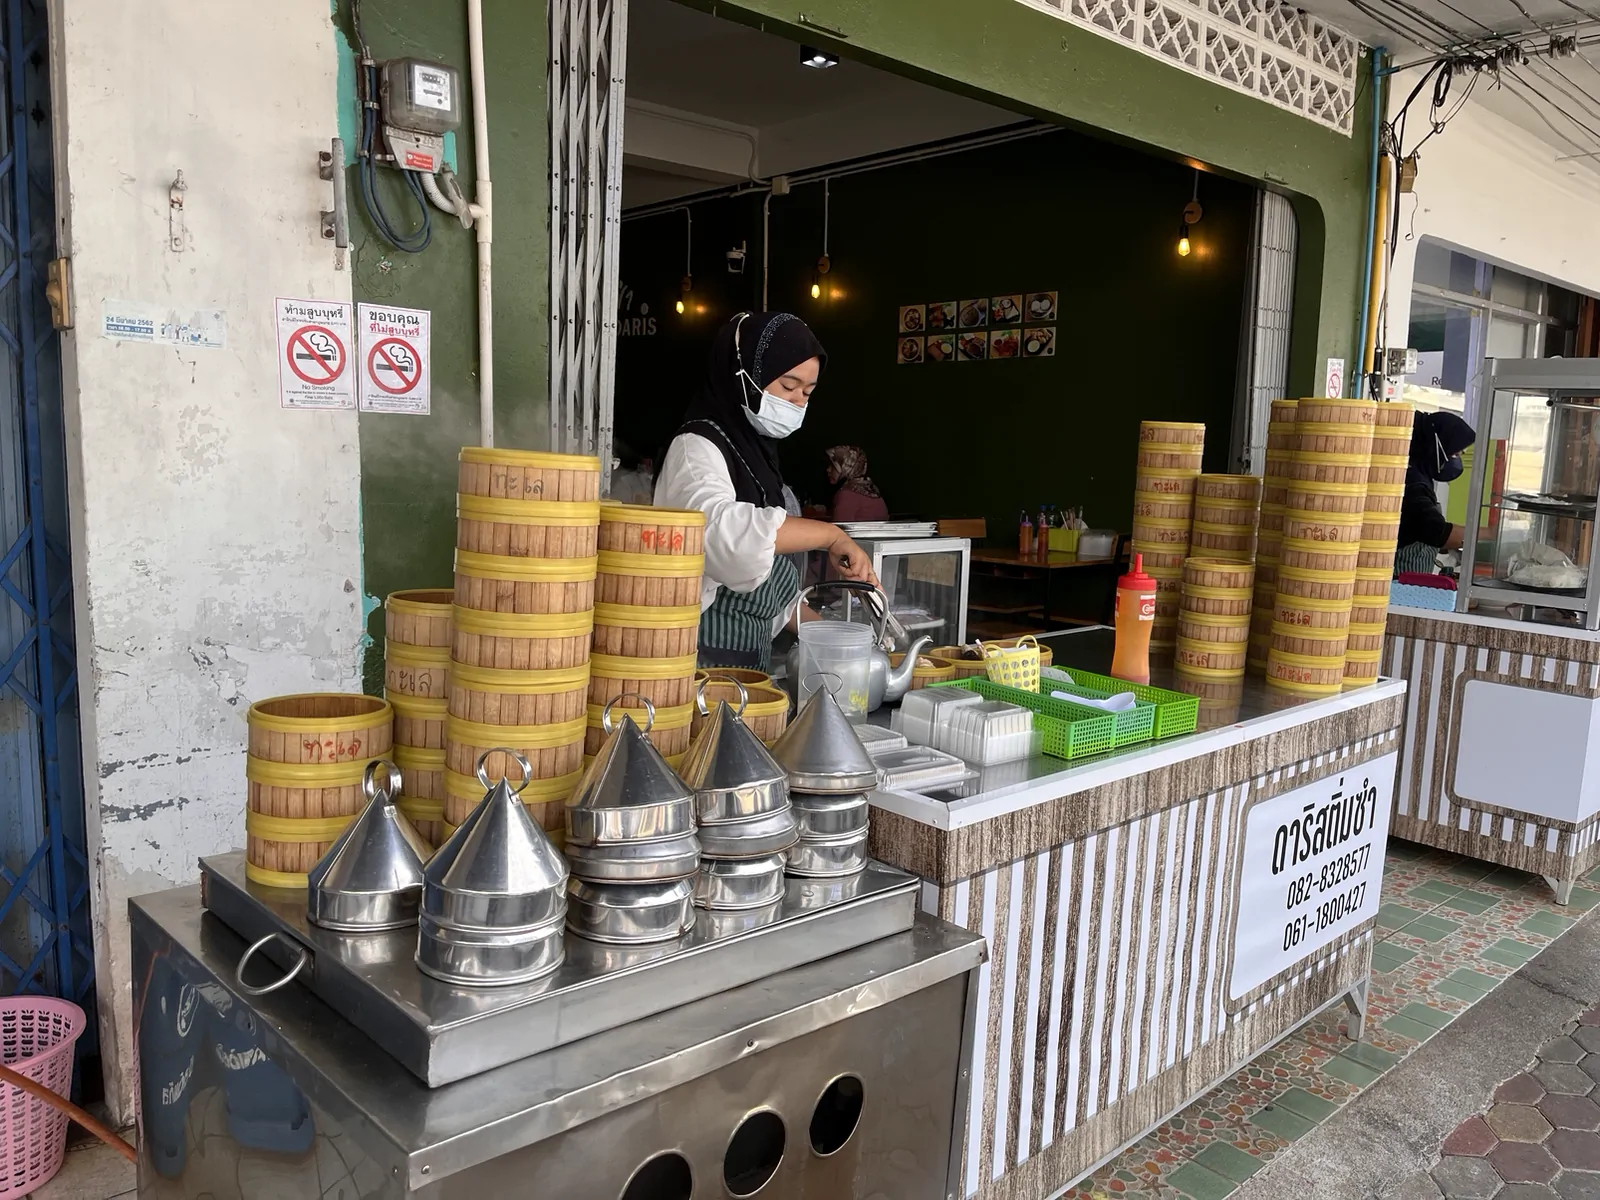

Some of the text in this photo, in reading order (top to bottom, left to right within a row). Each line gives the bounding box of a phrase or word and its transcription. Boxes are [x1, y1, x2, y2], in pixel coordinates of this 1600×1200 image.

[284, 304, 343, 320] ห้ามสูบบุหรี่
[369, 310, 420, 328] ขอบคุณ
[369, 322, 420, 337] ที่ไม่สูบบุหรี่
[493, 473, 544, 494] ทะเล
[641, 530, 684, 550] ทะเล
[1281, 610, 1311, 626] ทะเล
[388, 669, 432, 693] ทะเล
[303, 739, 362, 761] ทะเล
[1271, 777, 1377, 875] ดาริสติ่มซำ
[1286, 843, 1371, 910] 082-8328577
[1283, 881, 1367, 951] 061-1800427
